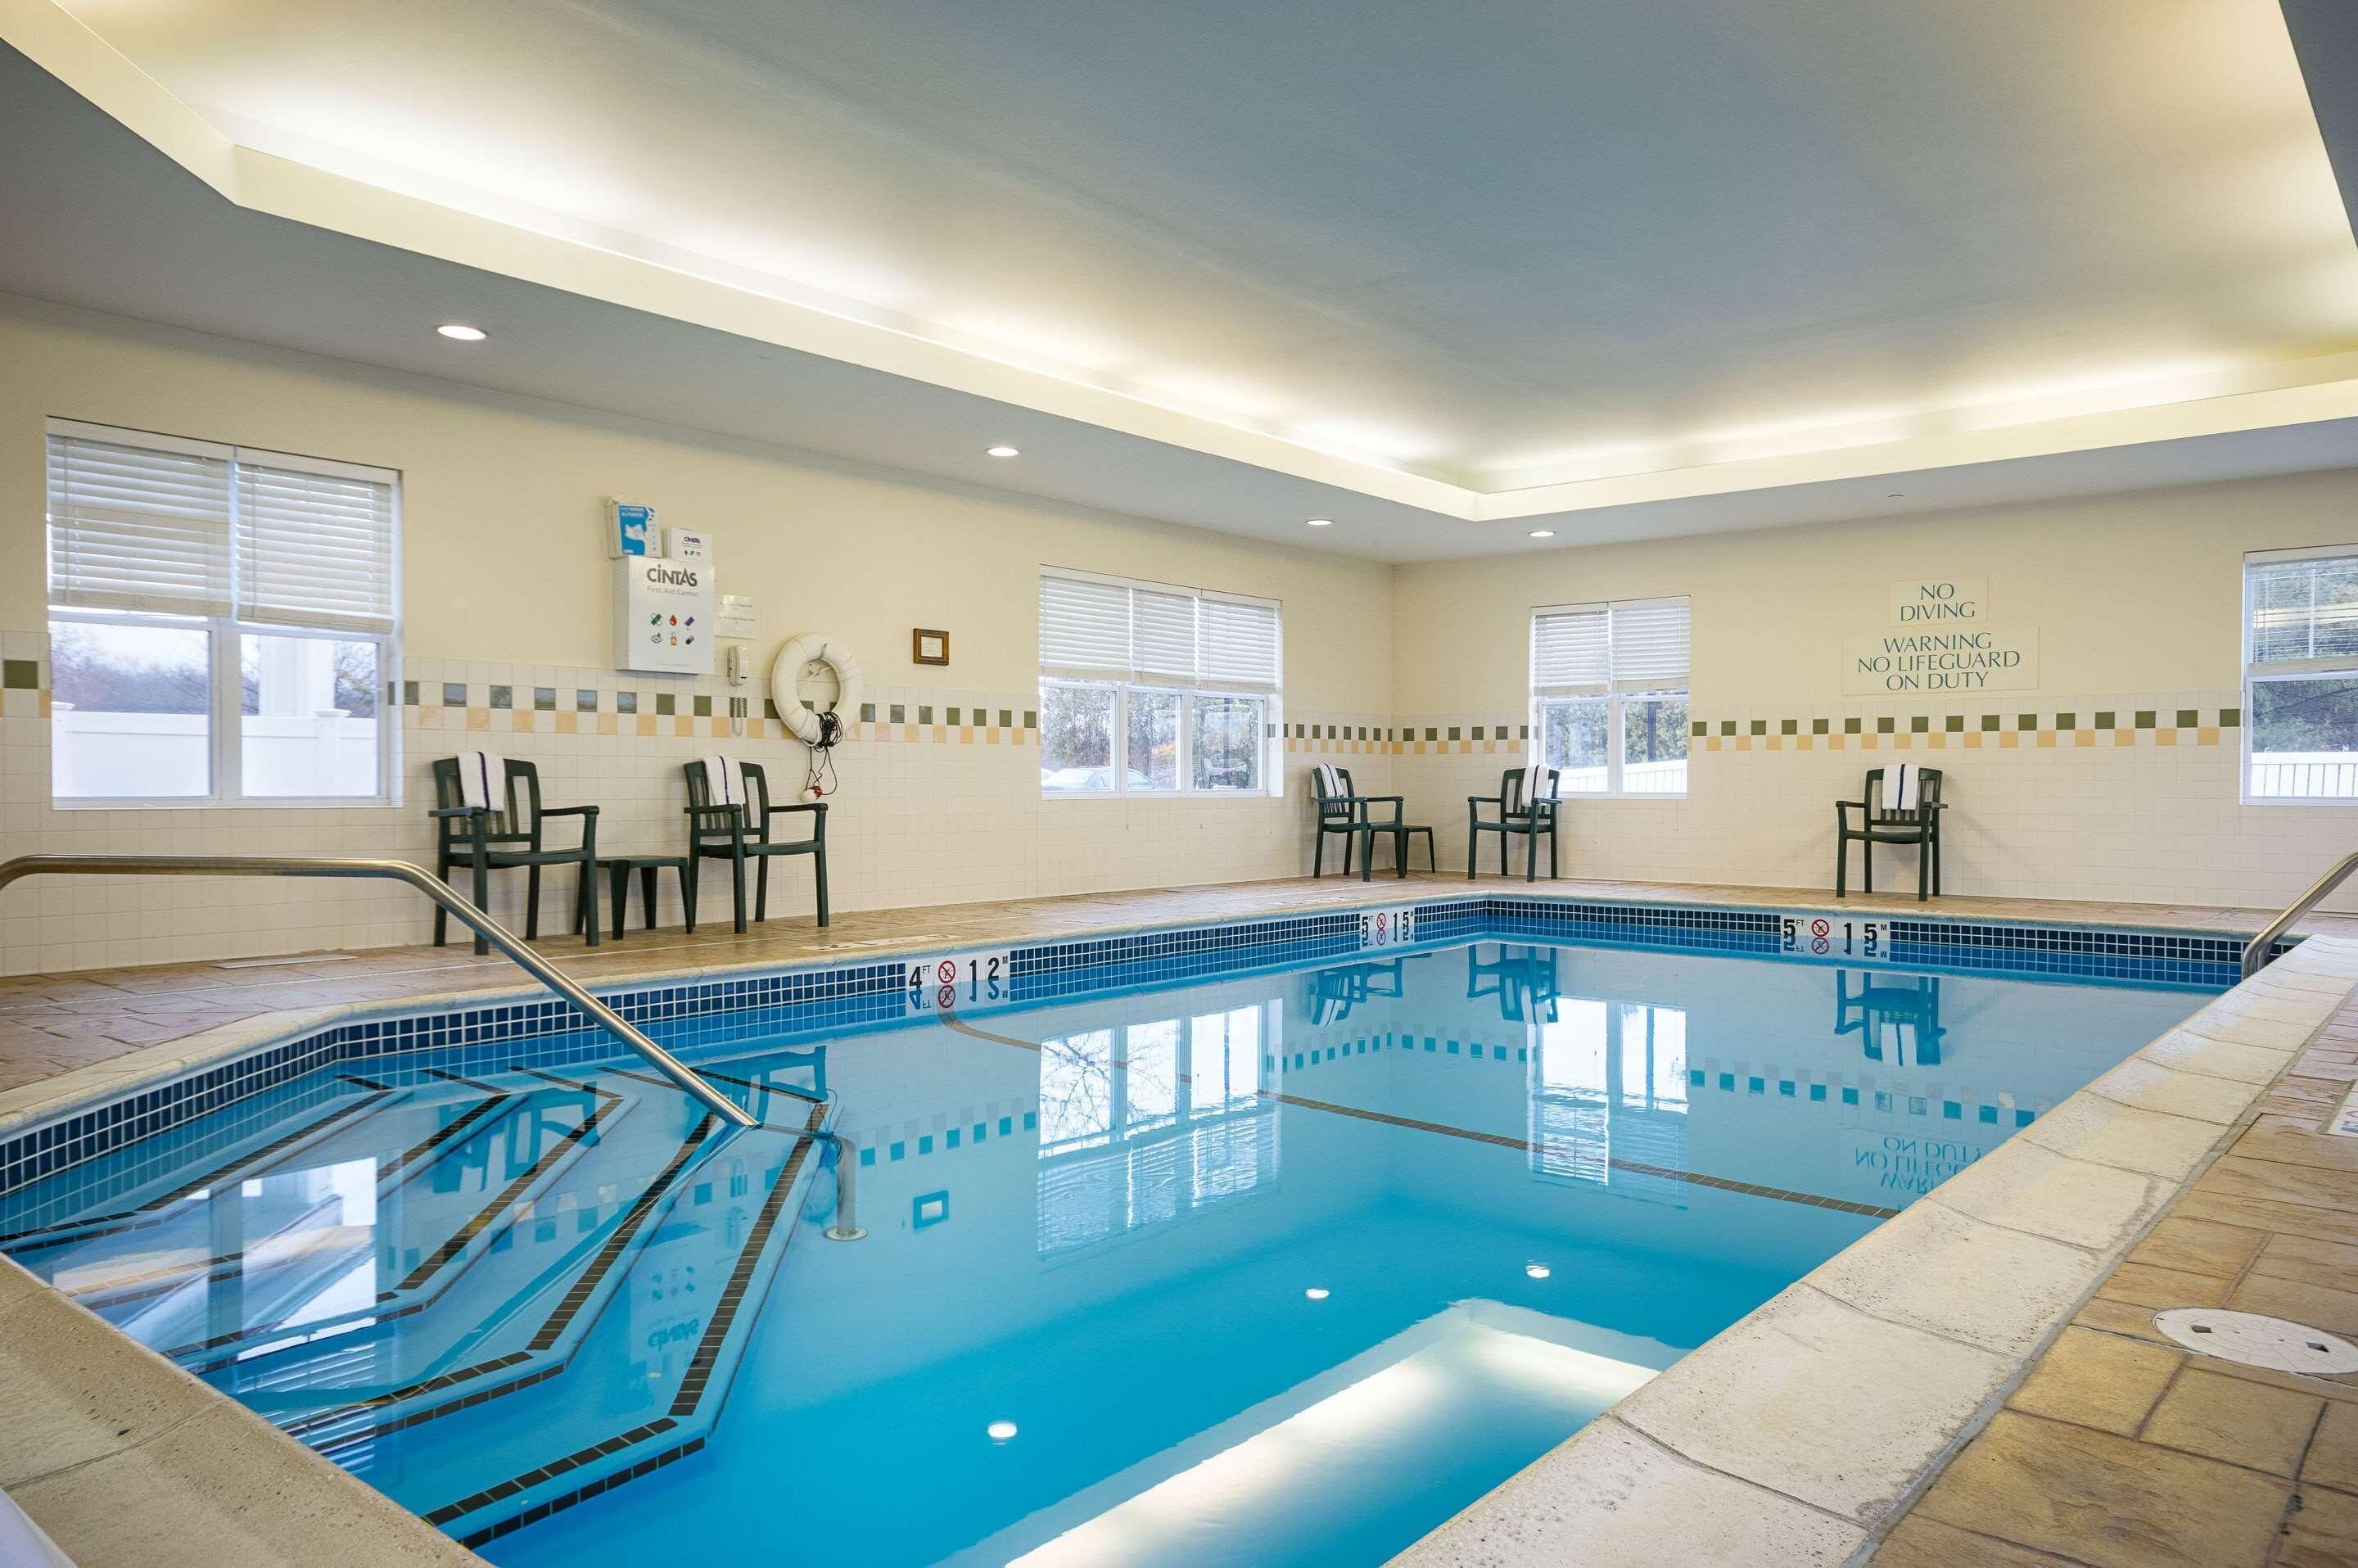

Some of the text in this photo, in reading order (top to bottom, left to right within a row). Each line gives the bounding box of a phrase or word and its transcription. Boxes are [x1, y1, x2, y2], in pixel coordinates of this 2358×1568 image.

[1920, 583, 1955, 601] NO
[1900, 601, 1976, 622] DIVING
[1883, 631, 1993, 653] WARNING
[1858, 649, 2021, 674] NO LIFEGUARD
[1886, 671, 1990, 691] ON DUTY
